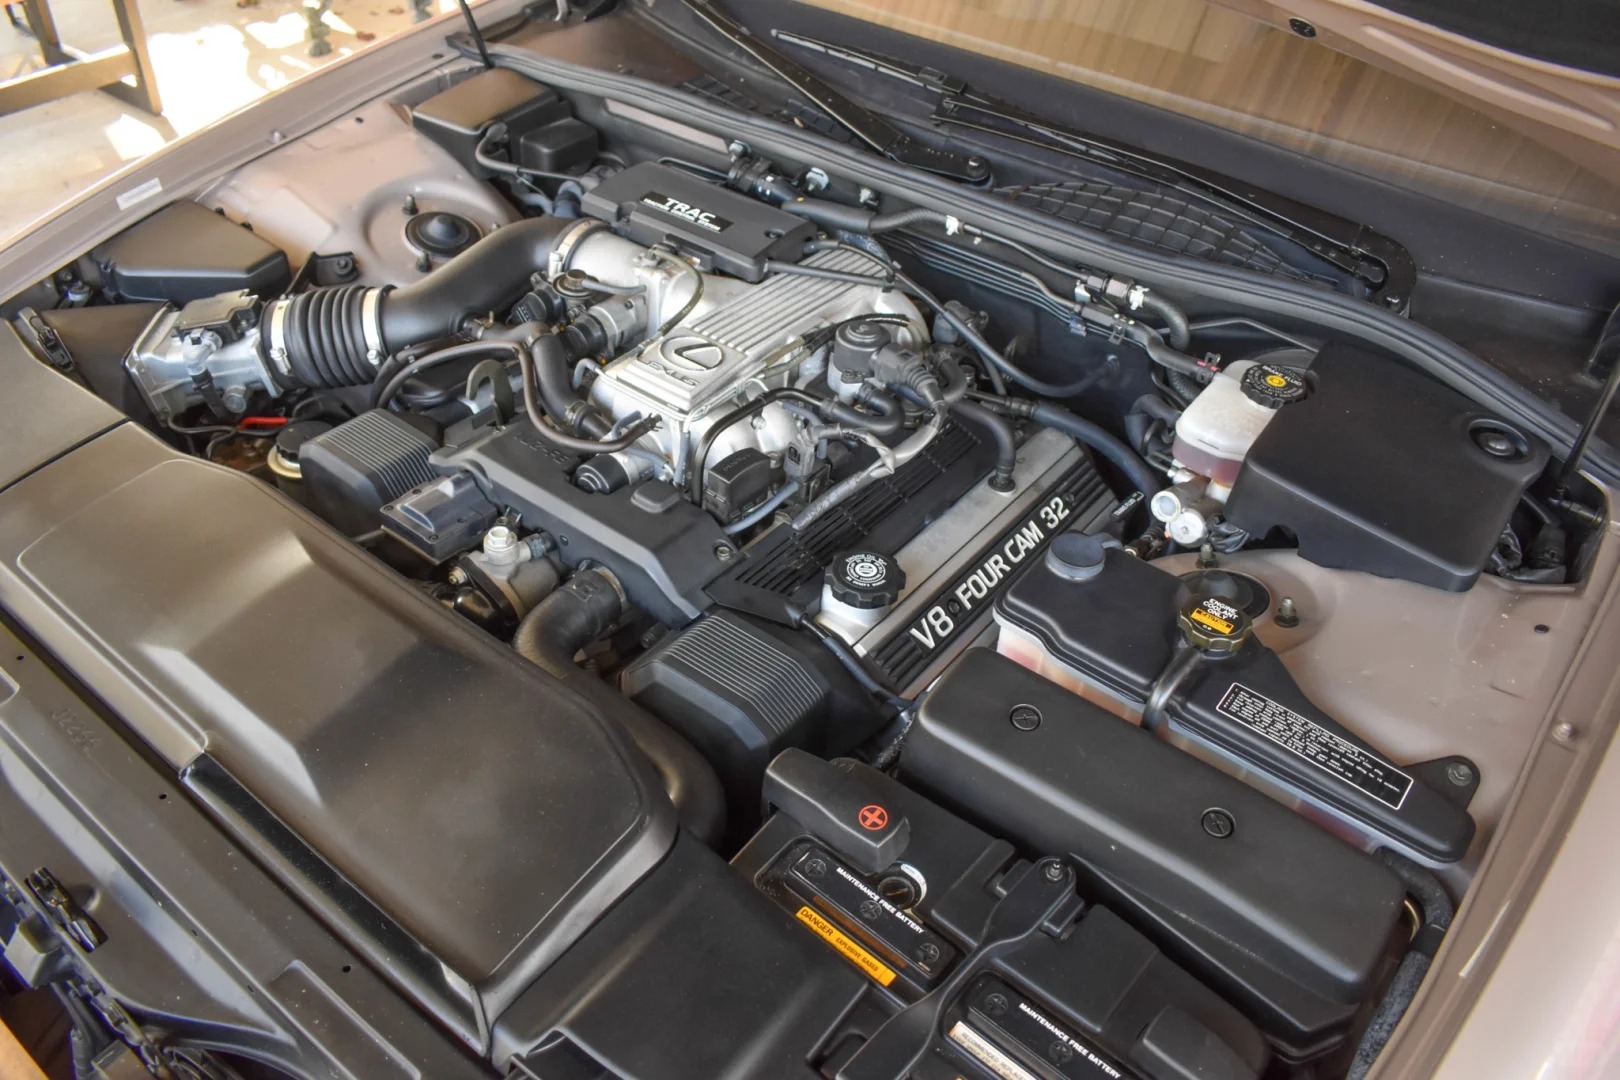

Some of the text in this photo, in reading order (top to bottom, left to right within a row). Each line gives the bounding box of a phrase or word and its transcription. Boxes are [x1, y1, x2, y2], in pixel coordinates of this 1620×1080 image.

[665, 197, 716, 223] TRAC
[1262, 365, 1302, 387] BRAKE FLUID
[909, 496, 1070, 650] V8 FOUR CAM 32
[1203, 600, 1239, 620] COOLANT
[1207, 608, 1228, 620] ONLY
[1209, 598, 1238, 614] ENGINE
[836, 866, 880, 903] MAINTENANCE
[878, 899, 898, 915] FREE
[895, 910, 925, 934] BATTERY
[800, 909, 834, 936] DANGER
[835, 937, 862, 960] EXPLOSIVE
[1019, 1002, 1122, 1080] MAINTENANCE FREE BATTERY
